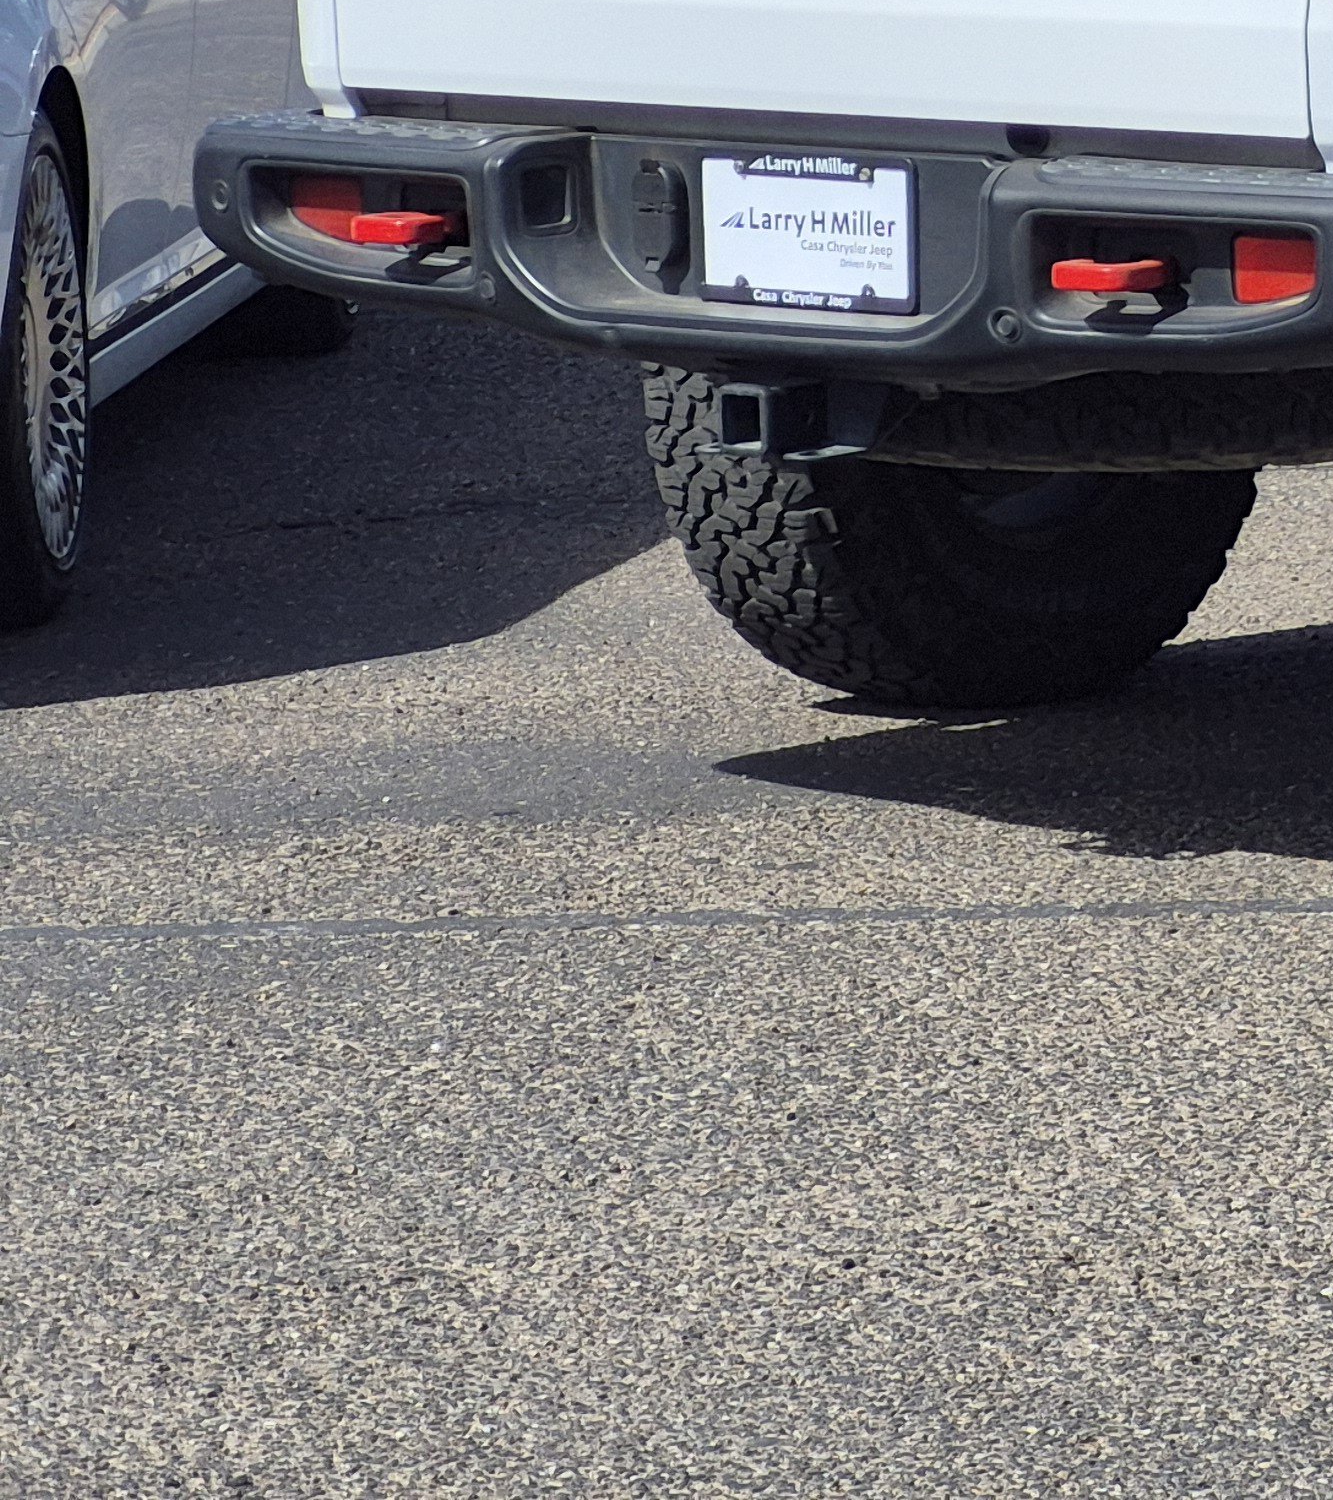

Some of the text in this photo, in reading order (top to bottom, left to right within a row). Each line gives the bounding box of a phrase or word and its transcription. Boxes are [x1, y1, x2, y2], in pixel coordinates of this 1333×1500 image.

[766, 155, 857, 176] Larry H Miller
[749, 206, 897, 238] Larry H Miller
[800, 240, 893, 258] Casa Chrysler Jeep
[753, 288, 852, 309] Casa Chrysler Jeep
